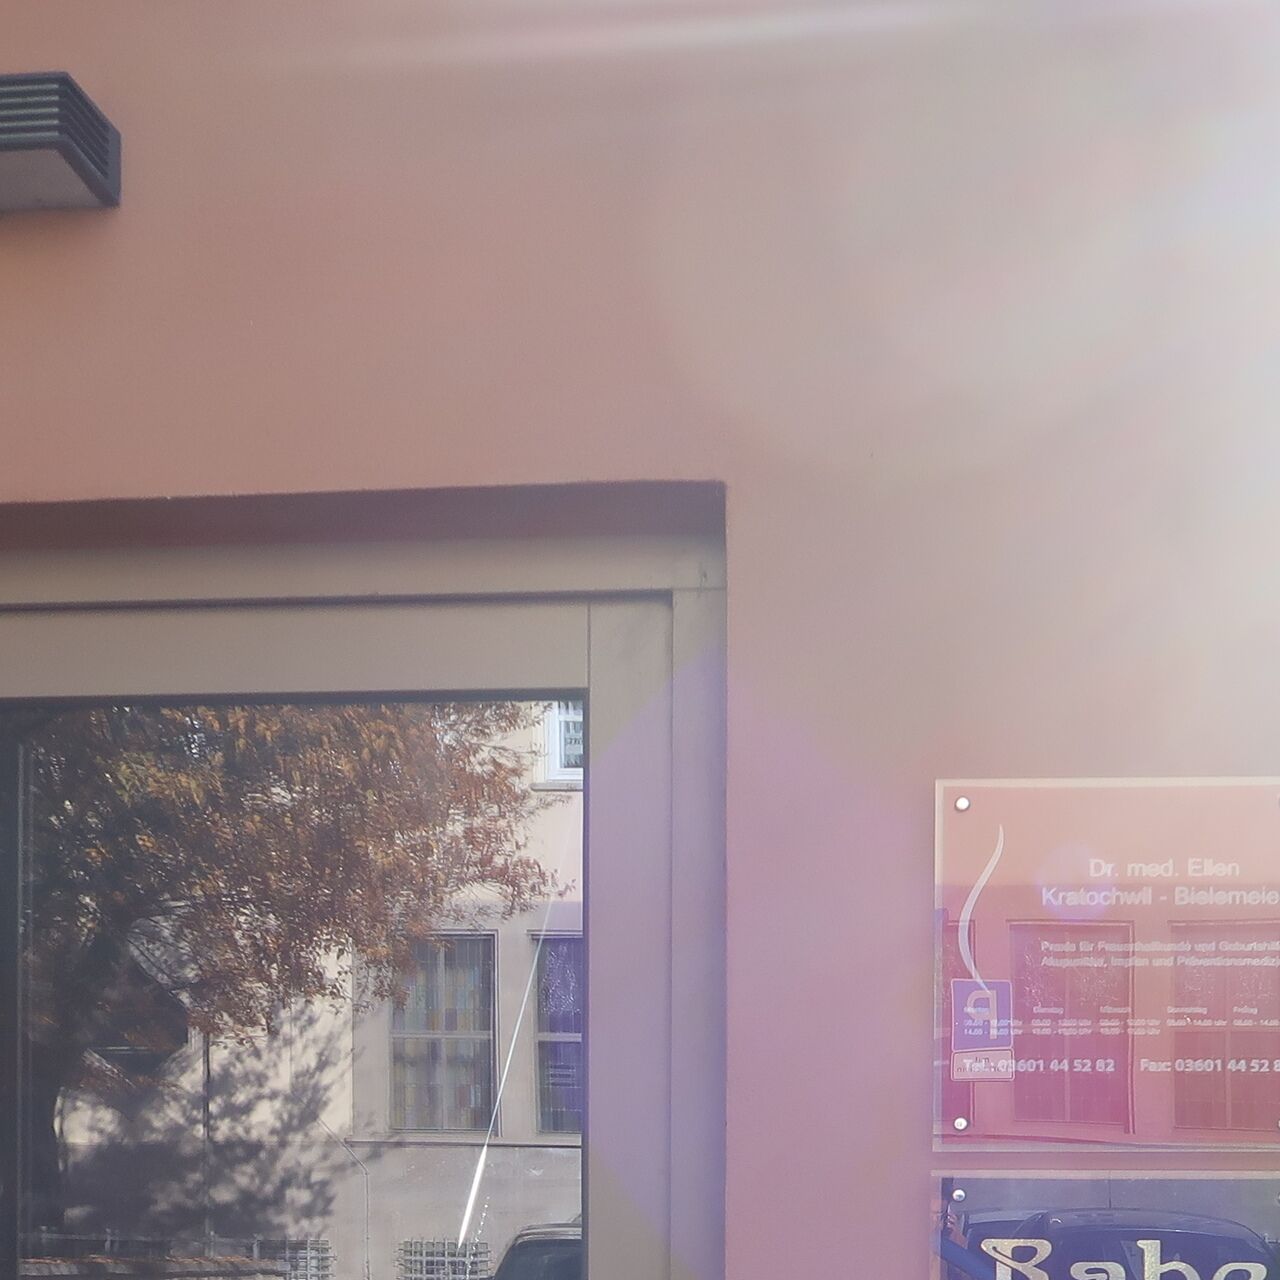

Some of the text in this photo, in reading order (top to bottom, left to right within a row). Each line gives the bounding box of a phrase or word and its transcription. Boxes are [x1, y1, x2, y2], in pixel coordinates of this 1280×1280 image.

[1088, 857, 1240, 877] Dr. med. Ellen
[1049, 1058, 1069, 1072] 44
[1072, 1058, 1092, 1072] 52
[1174, 1058, 1222, 1072] 03601
[1227, 1058, 1247, 1072] 44
[1250, 1058, 1270, 1072] 52
